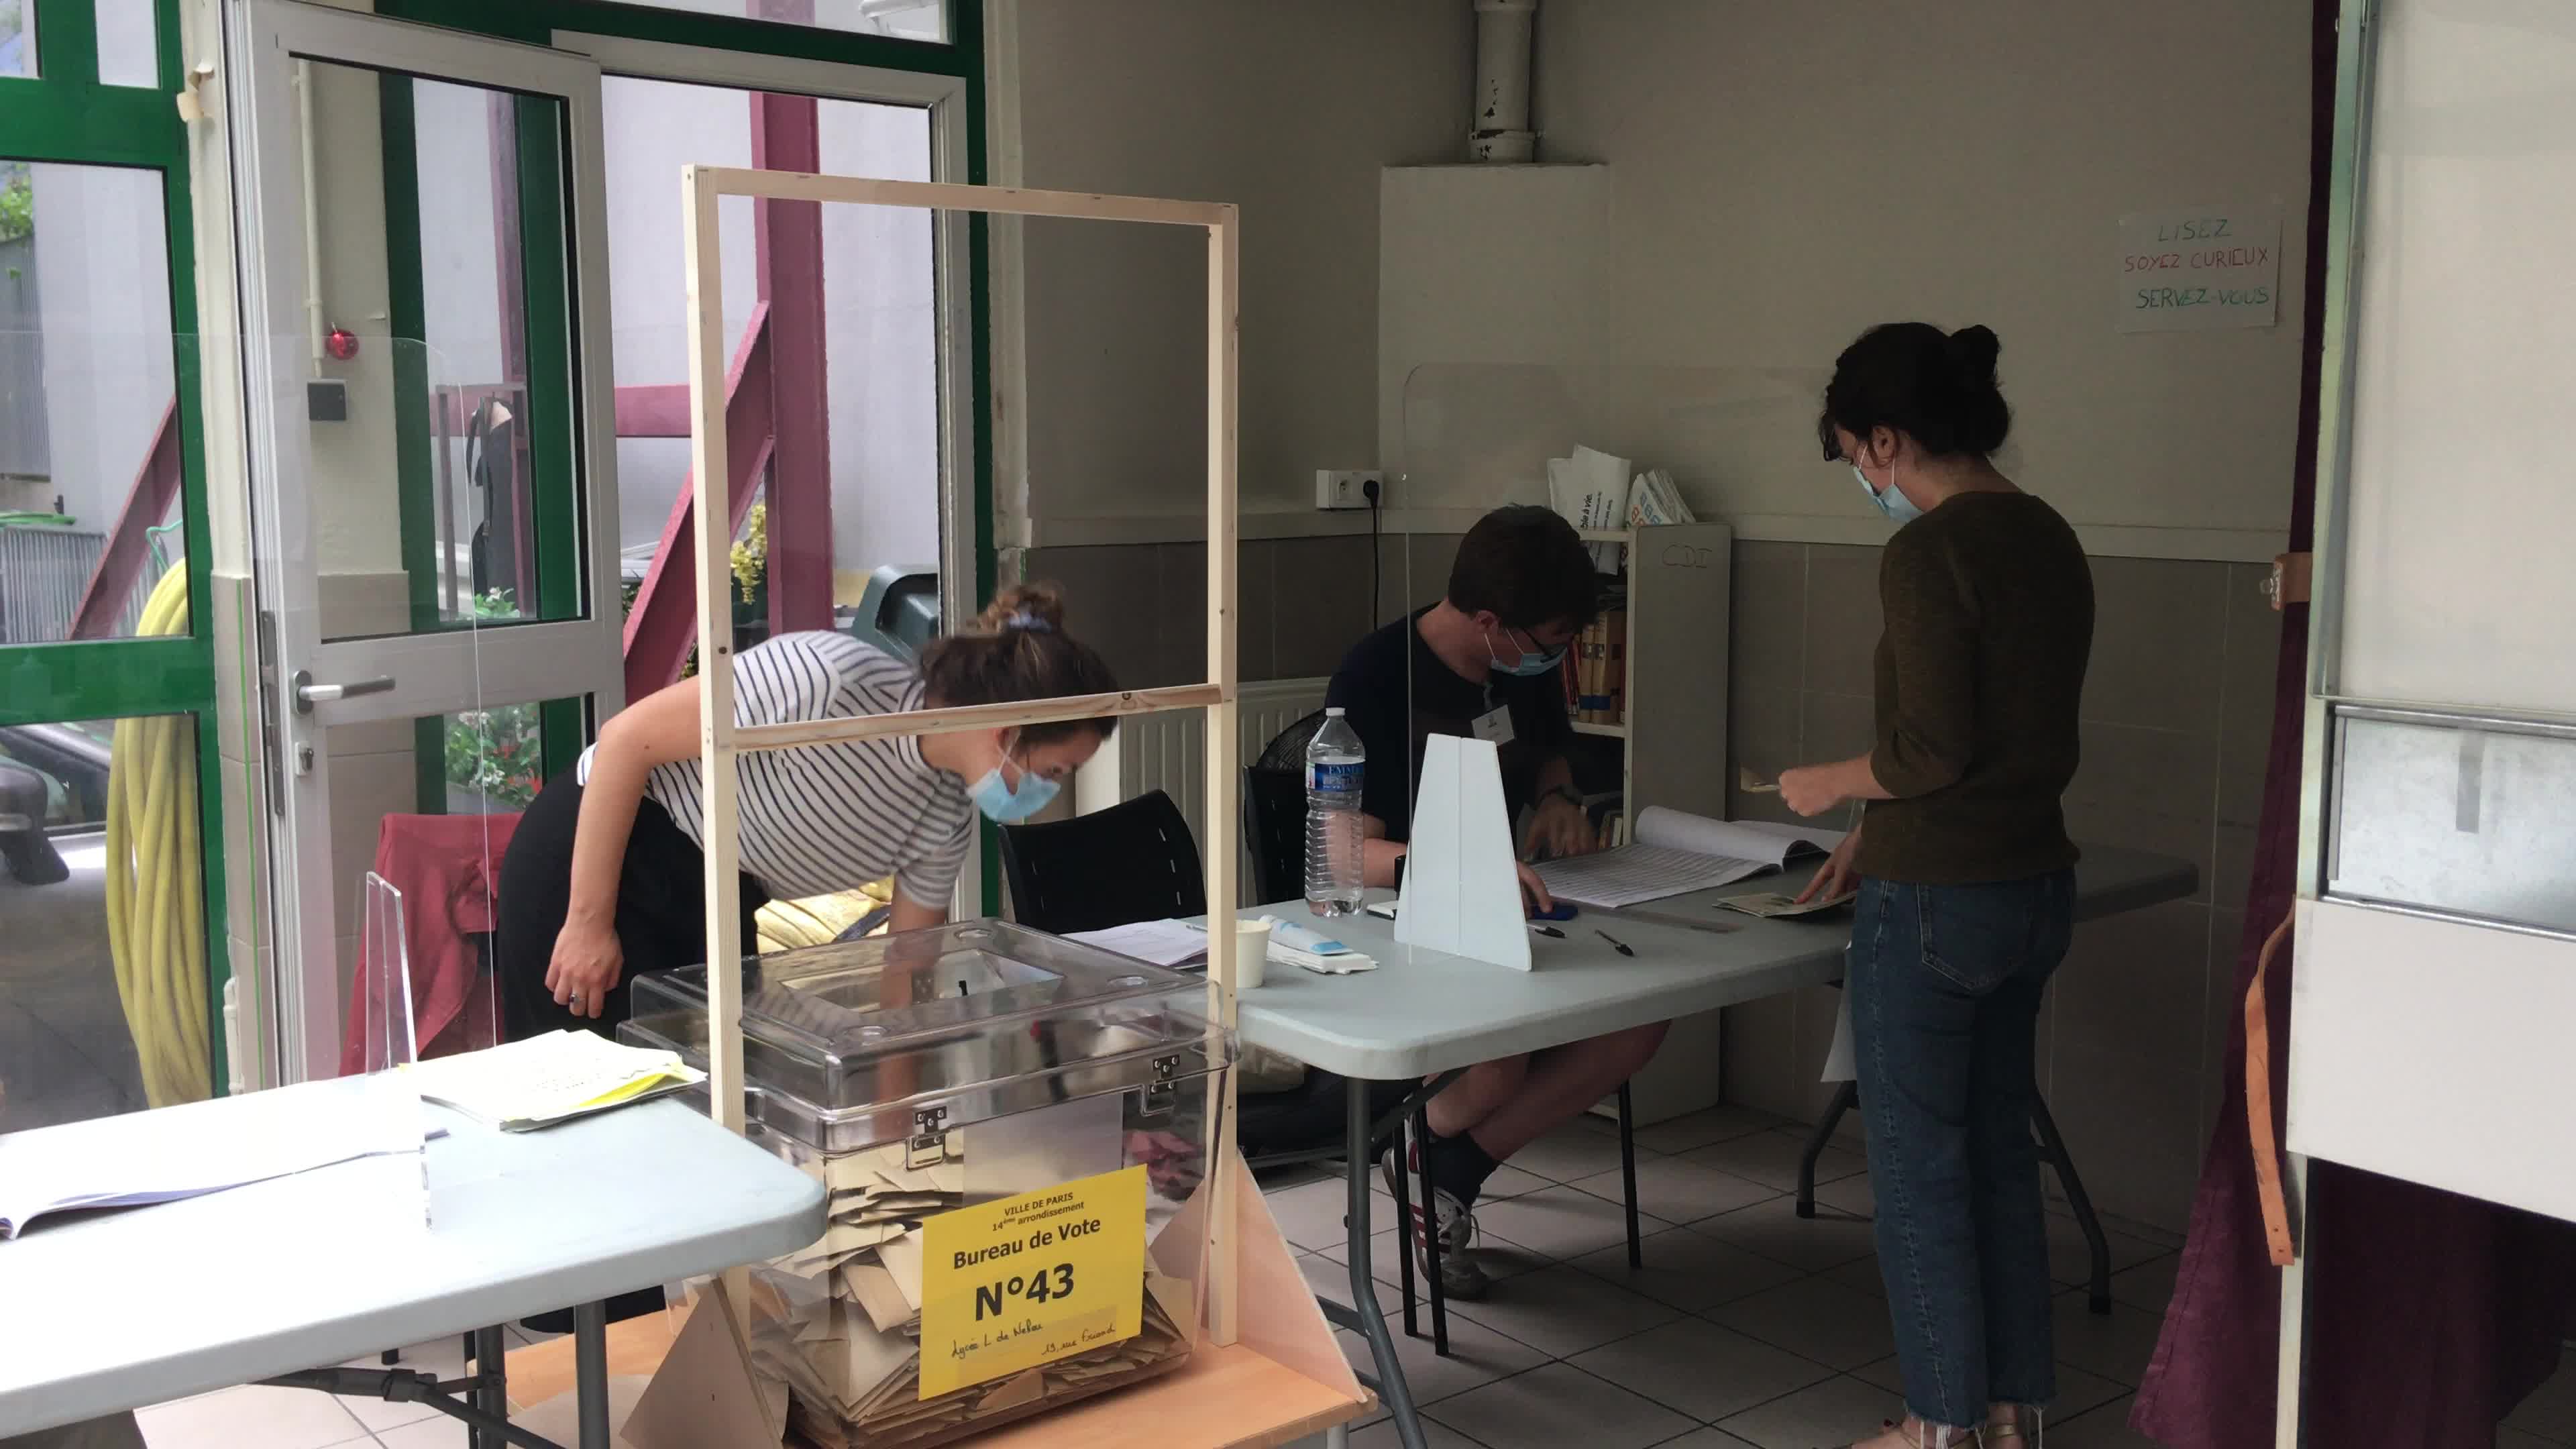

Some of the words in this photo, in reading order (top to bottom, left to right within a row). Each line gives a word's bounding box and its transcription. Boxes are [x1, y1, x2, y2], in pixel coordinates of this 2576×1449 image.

[2157, 218, 2233, 242] LISEZ
[2125, 252, 2182, 274] SOYEZ
[2190, 246, 2270, 269] CURIEUX
[1004, 1203, 1030, 1217] VILLE
[1032, 1199, 1043, 1209] DE
[1046, 1192, 1073, 1206] PARIS
[1018, 1201, 1085, 1225] arrondissement
[954, 1239, 1023, 1270] Bureau
[1029, 1230, 1053, 1249] de
[1058, 1218, 1101, 1241] Vote
